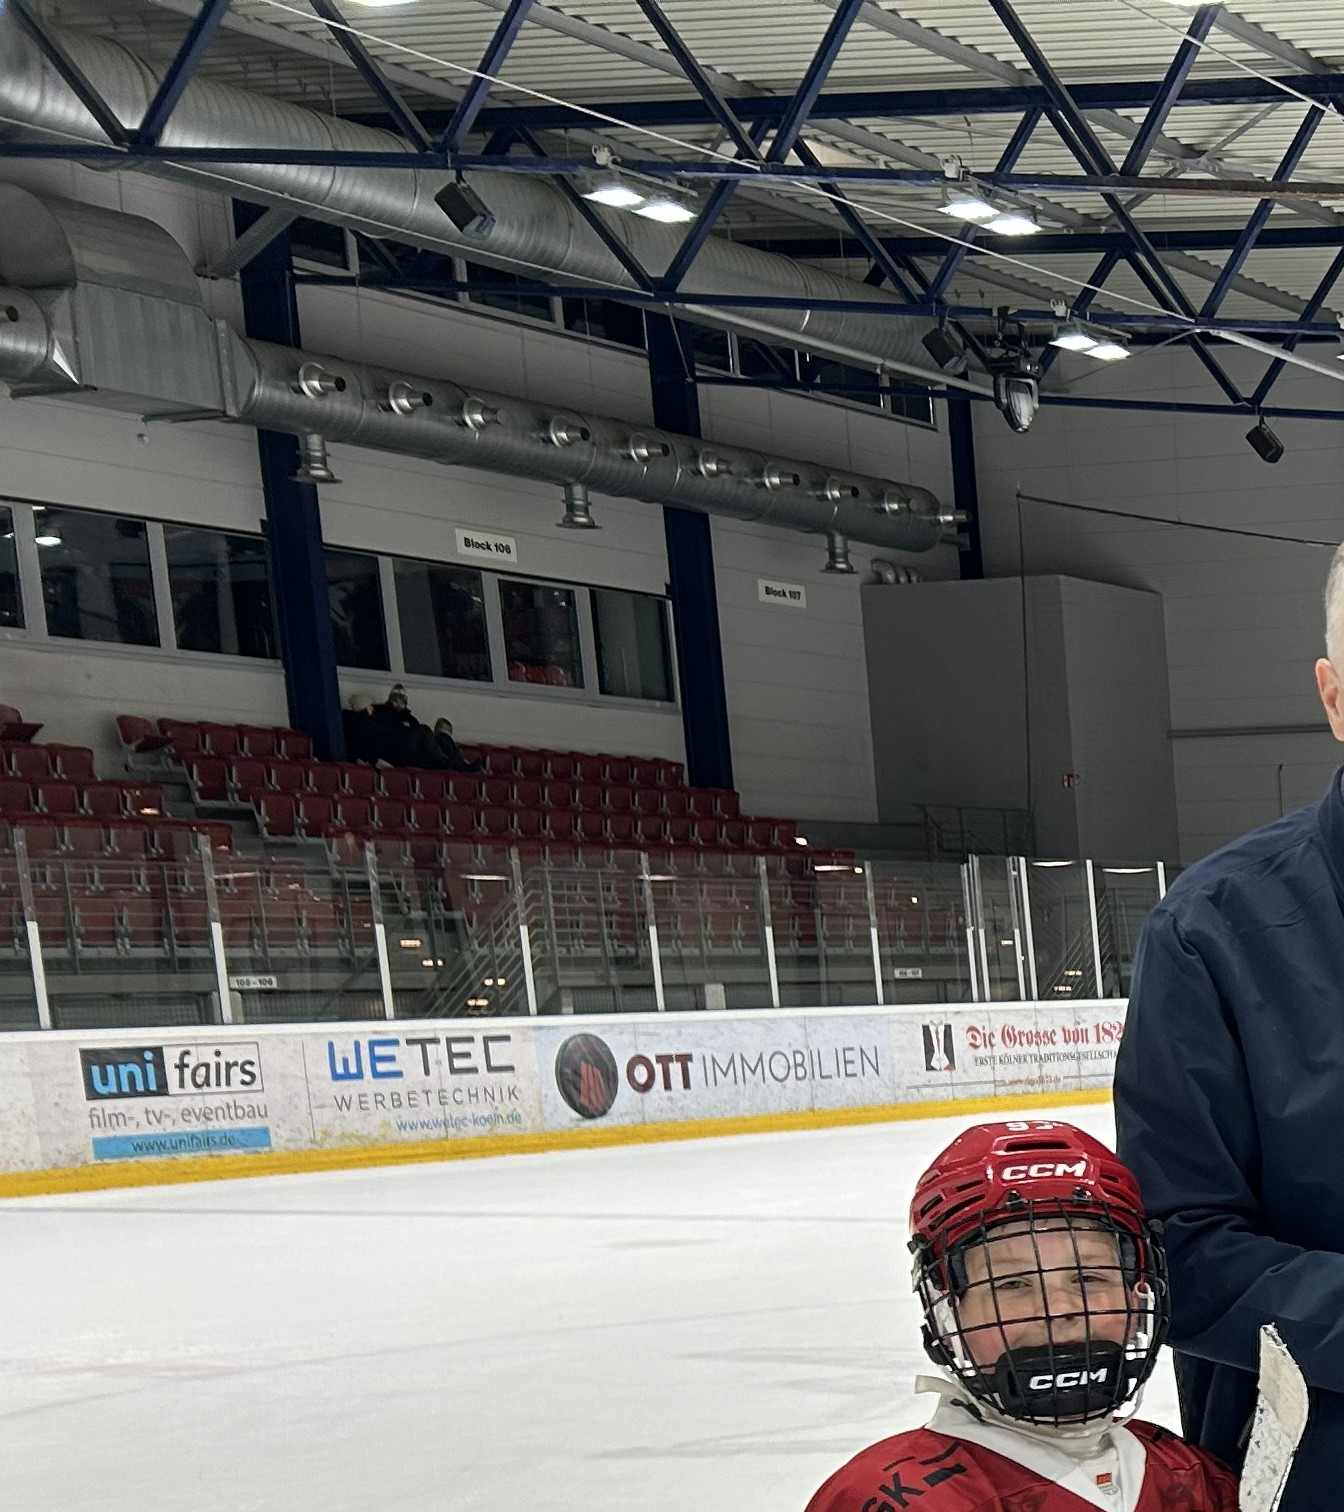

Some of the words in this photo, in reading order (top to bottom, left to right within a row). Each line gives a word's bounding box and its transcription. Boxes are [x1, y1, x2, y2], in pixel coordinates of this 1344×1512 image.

[464, 536, 492, 552] Block
[966, 1025, 996, 1050] Die
[1094, 1021, 1124, 1044] 182
[327, 1034, 515, 1081] WETEC
[626, 1054, 693, 1093] OTT
[703, 1046, 881, 1087] IMMOBILIEN
[90, 1051, 157, 1095] uni
[174, 1049, 257, 1089] fairs
[333, 1085, 519, 1112] WERBETECHNIK
[88, 1107, 140, 1129] film-,
[181, 1100, 268, 1124] eventbau
[132, 1133, 236, 1153] www.unifairs.de
[1001, 1160, 1087, 1180] CCM
[1029, 1367, 1107, 1390] CCM
